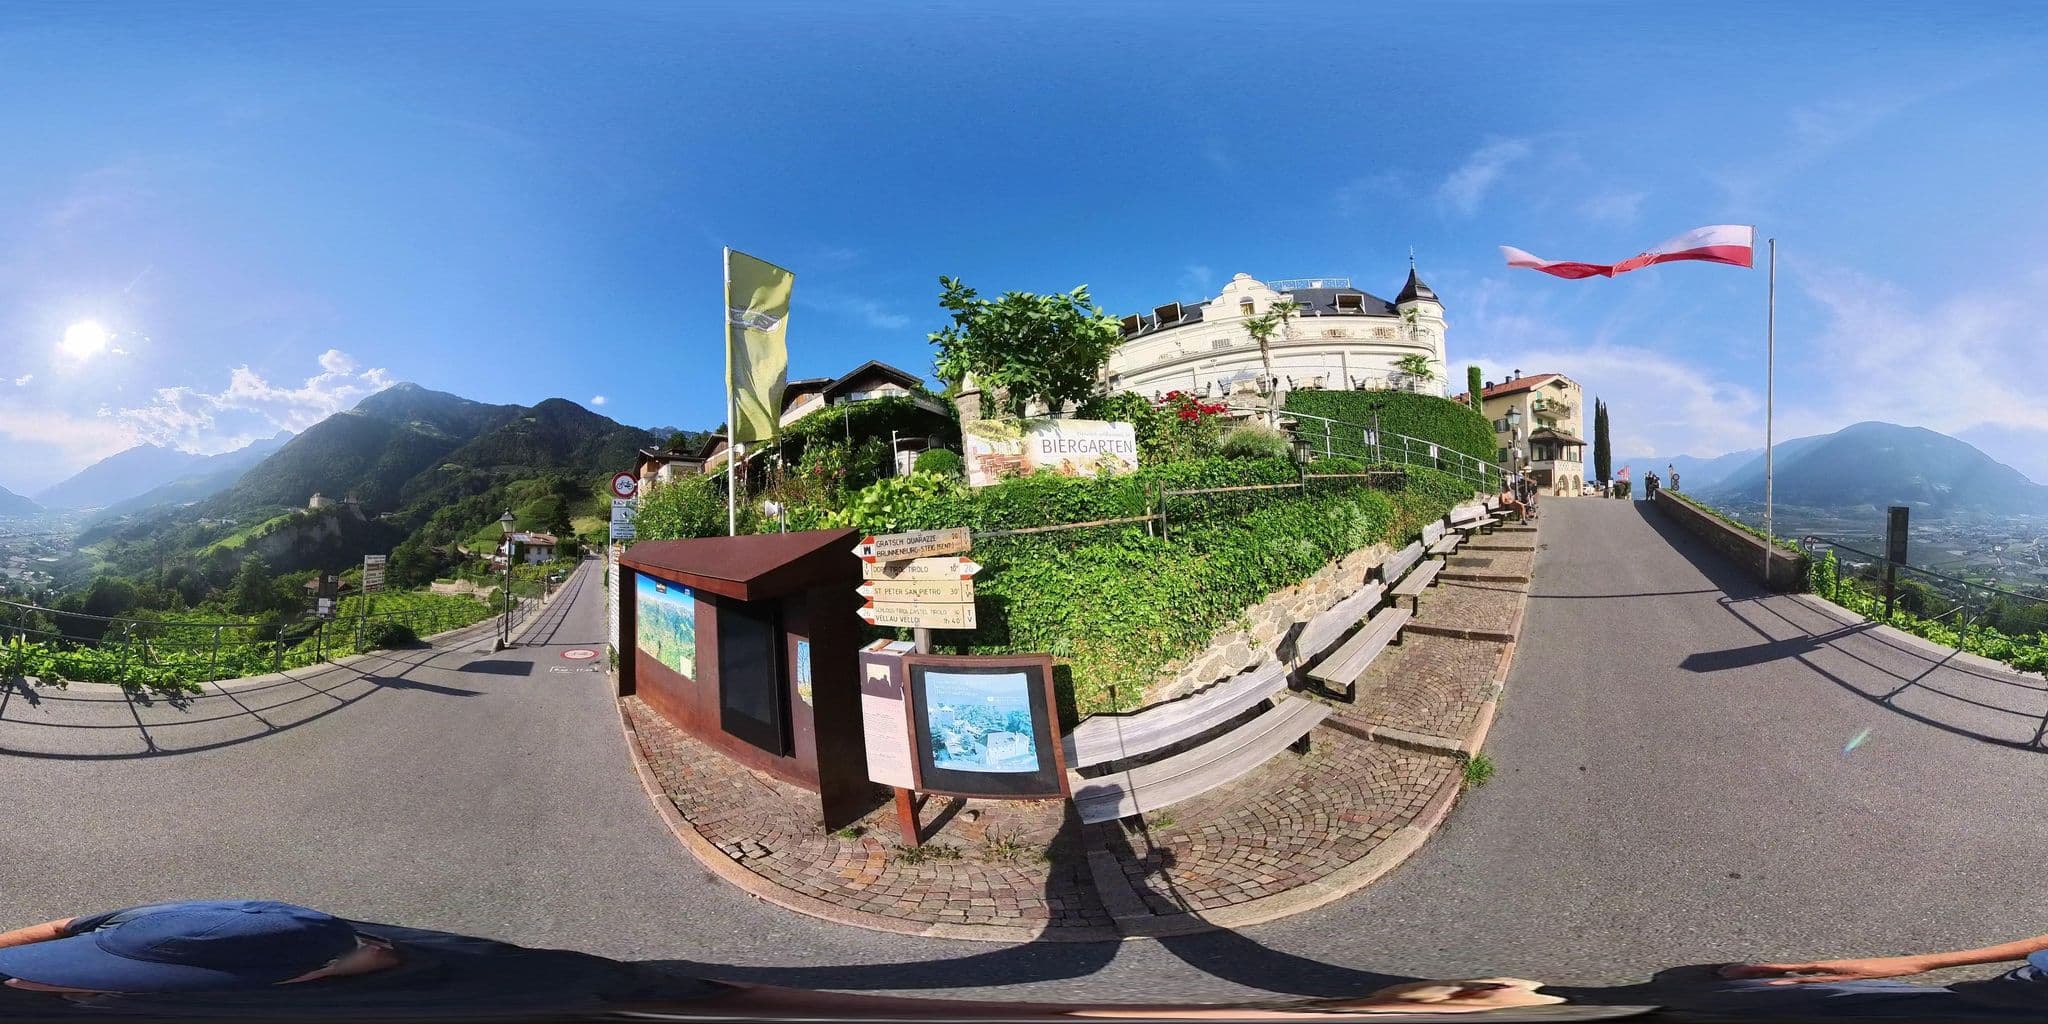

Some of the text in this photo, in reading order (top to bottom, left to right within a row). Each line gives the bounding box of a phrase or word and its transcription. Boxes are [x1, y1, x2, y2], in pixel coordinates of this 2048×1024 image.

[1042, 439, 1133, 454] BIERGARTEN
[876, 538, 904, 548] GRATSCH
[906, 534, 937, 545] QUARAZZE
[904, 588, 918, 596] SAN
[919, 588, 942, 596] PIETRO
